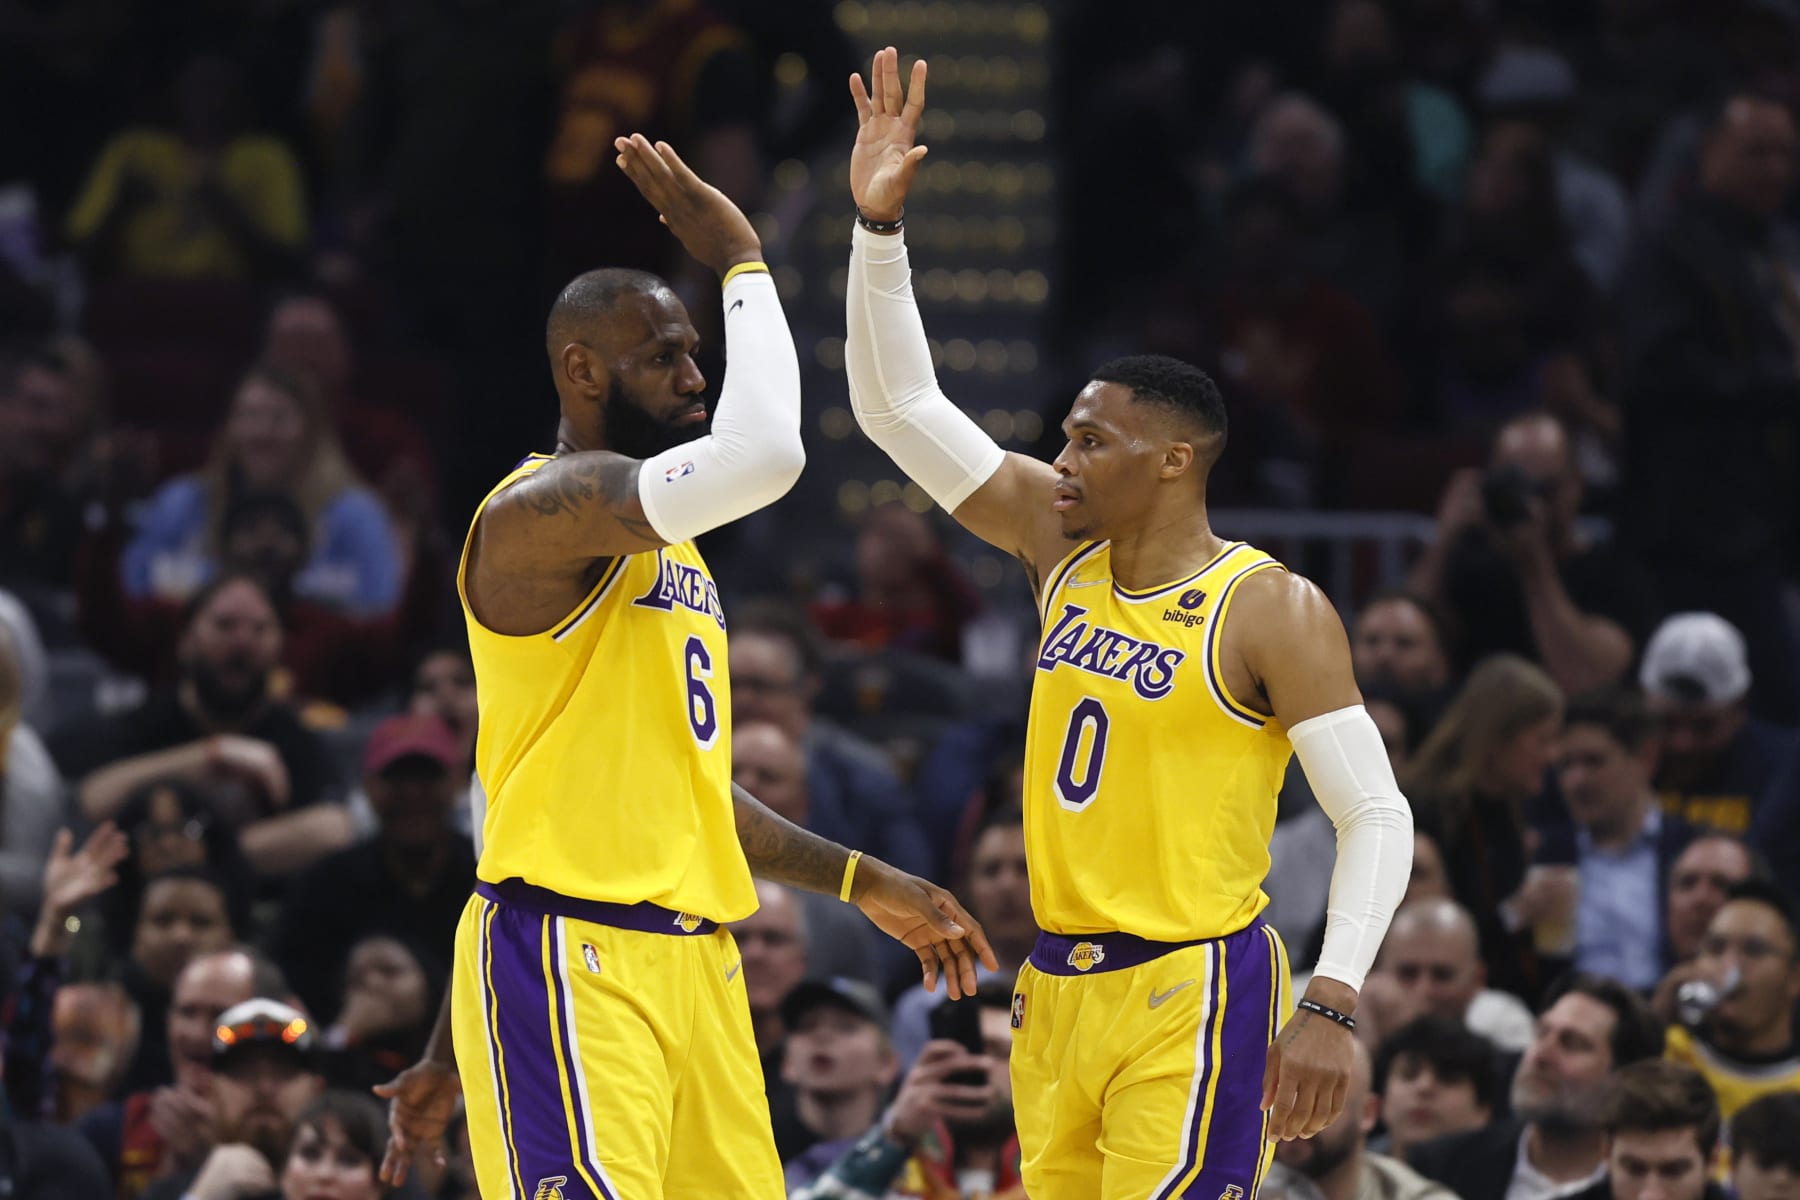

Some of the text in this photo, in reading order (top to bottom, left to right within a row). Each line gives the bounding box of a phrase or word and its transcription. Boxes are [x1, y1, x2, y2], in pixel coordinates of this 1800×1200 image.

[1036, 604, 1187, 701] LAKERS
[1163, 609, 1205, 628] bibigo
[683, 633, 720, 751] 6
[1053, 696, 1110, 813] 0
